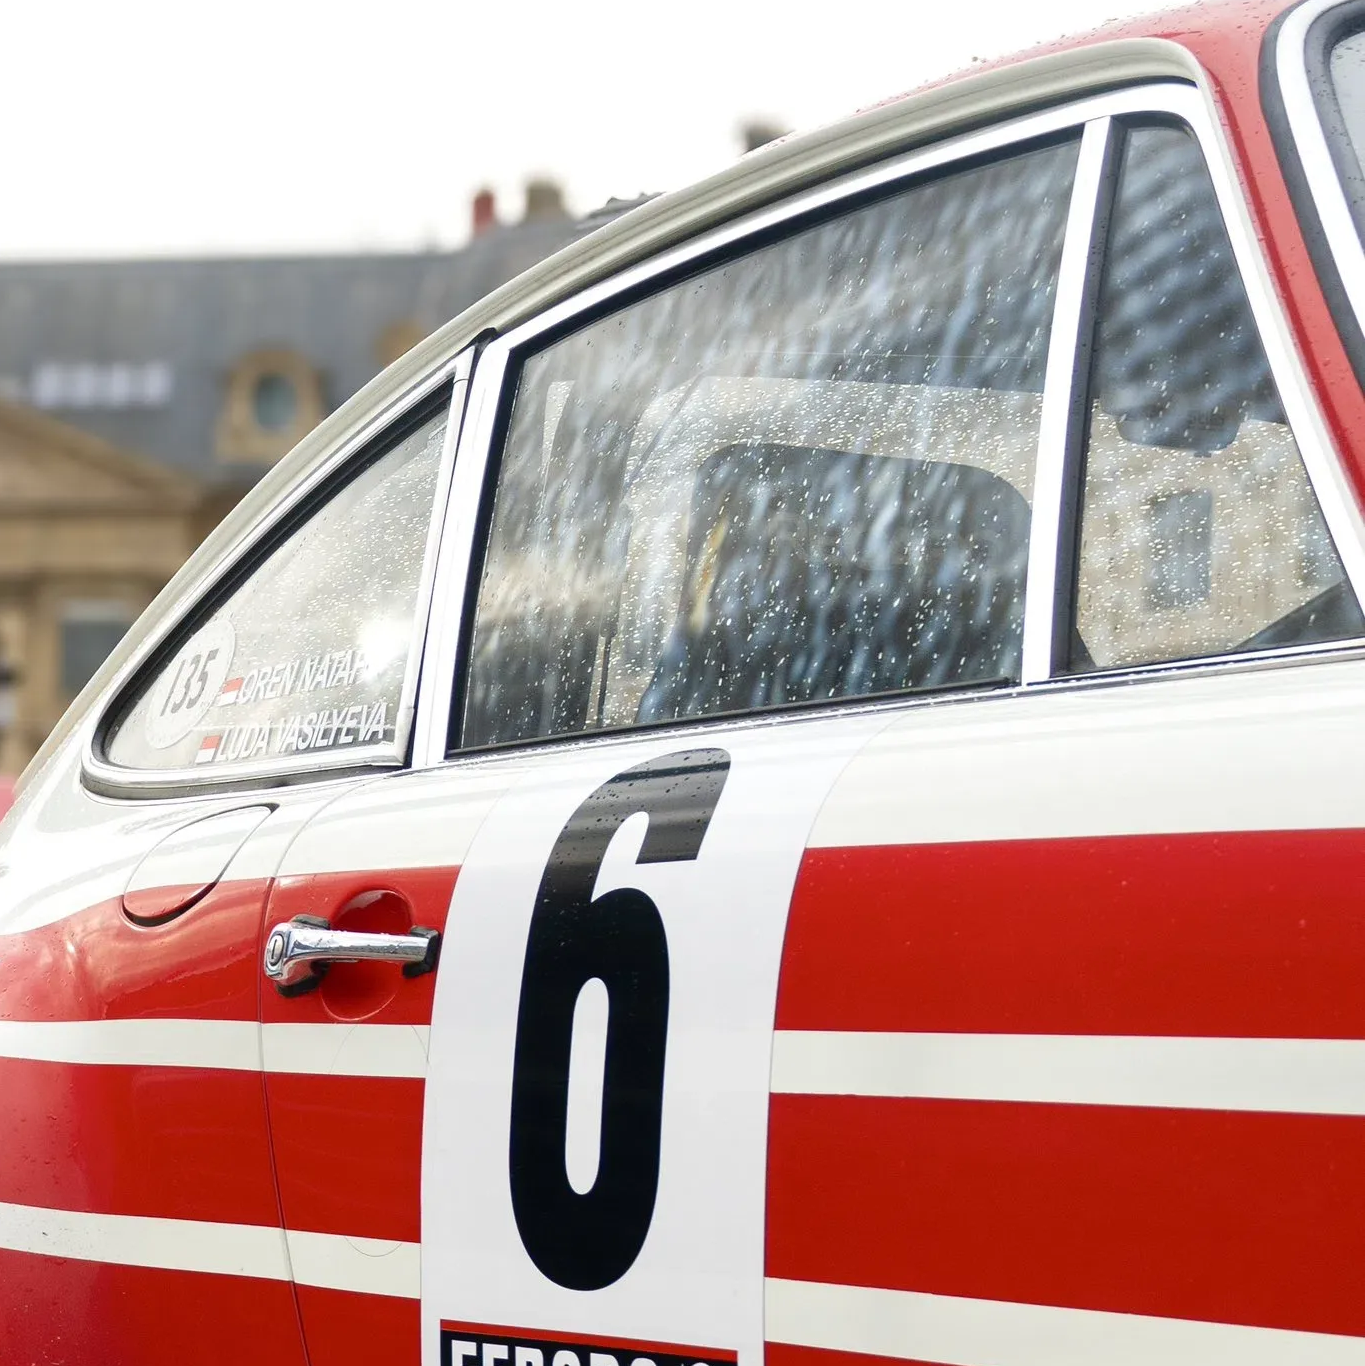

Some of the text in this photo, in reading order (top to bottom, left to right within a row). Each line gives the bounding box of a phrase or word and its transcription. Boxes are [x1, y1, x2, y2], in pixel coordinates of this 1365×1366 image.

[160, 648, 219, 717] 135
[236, 659, 301, 705] OREN
[215, 701, 389, 763] LUDA VASILYEVA
[508, 746, 732, 1292] 6
